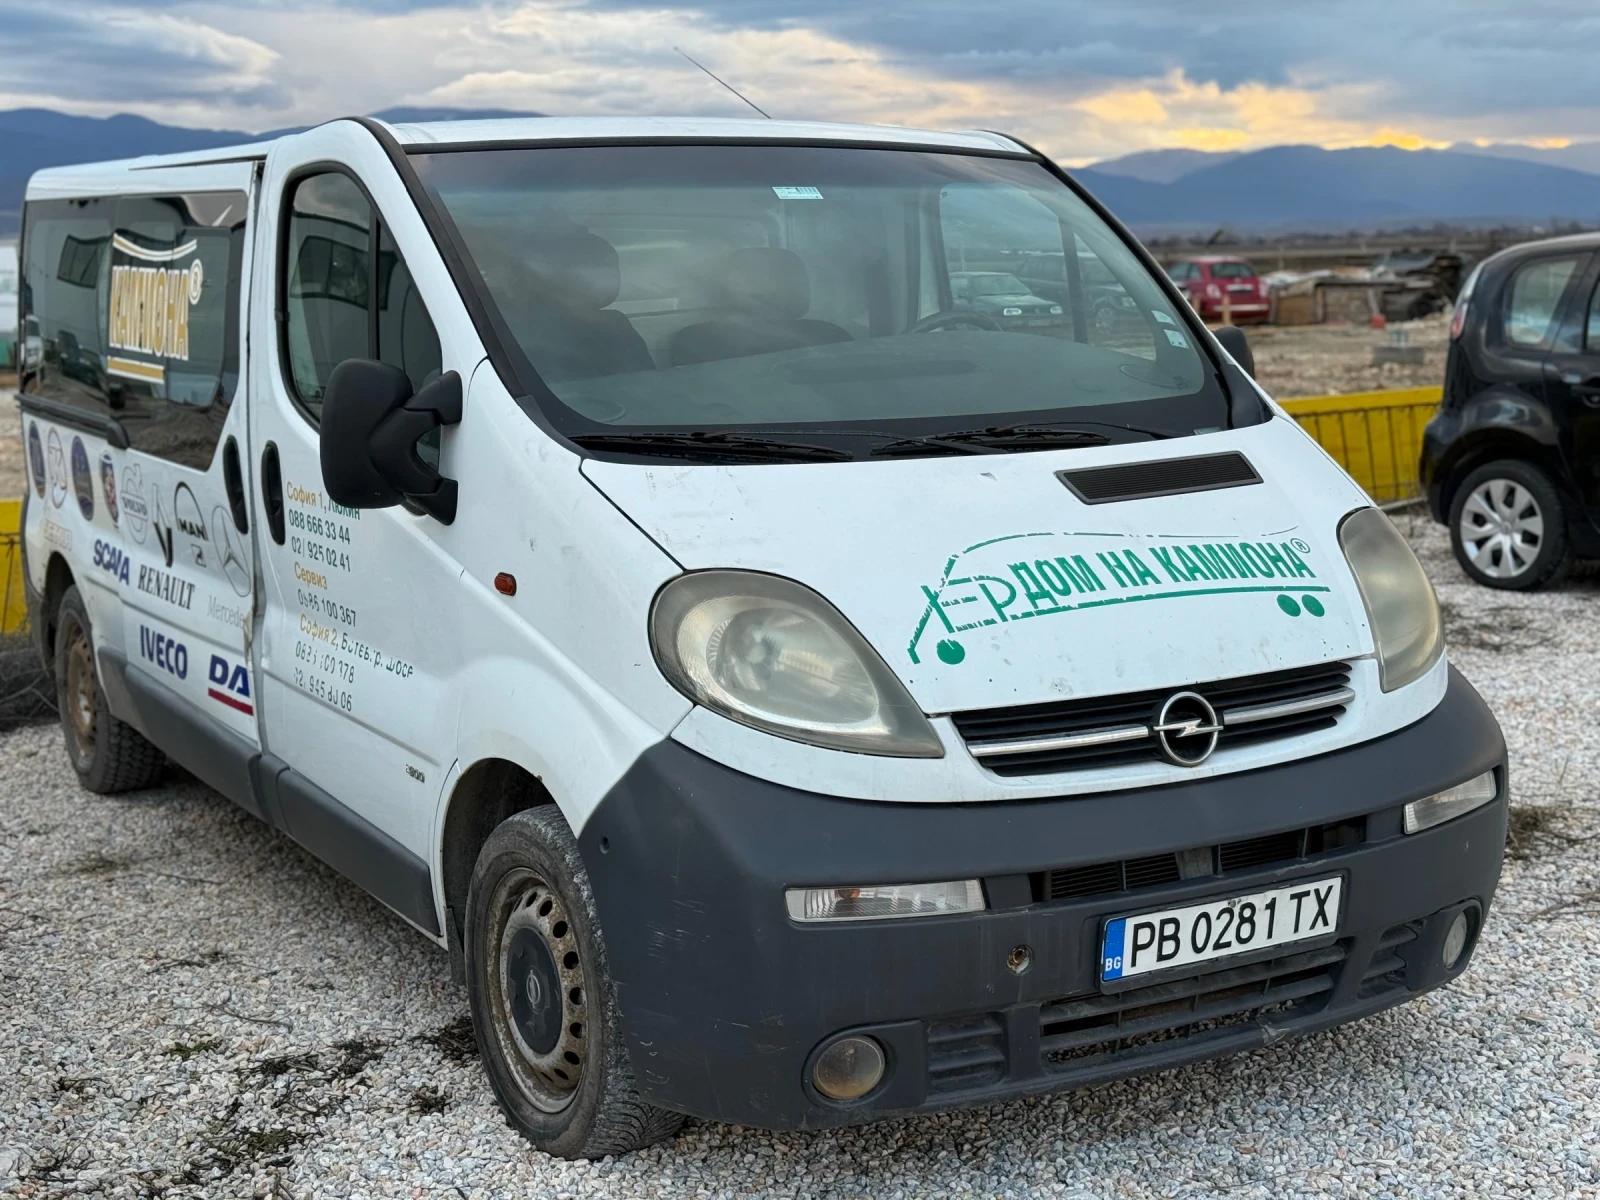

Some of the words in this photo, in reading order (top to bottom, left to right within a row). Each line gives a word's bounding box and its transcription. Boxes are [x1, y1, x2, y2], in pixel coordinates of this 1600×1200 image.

[286, 481, 317, 508] София
[178, 517, 209, 541] MAN
[288, 508, 305, 530] 088
[306, 514, 323, 536] 666
[324, 520, 337, 541] 33
[338, 525, 351, 546] 44
[307, 541, 325, 563] 925
[325, 547, 338, 569] 02
[339, 552, 351, 573] 41
[137, 564, 195, 610] RENAULT
[294, 561, 328, 590] Сервиз
[1007, 555, 1107, 609] ДОМ
[1095, 549, 1162, 588] НА
[300, 613, 330, 643] София
[321, 598, 338, 620] 100
[339, 605, 356, 628] 367
[140, 624, 188, 680] IVECO
[340, 691, 352, 713] 06
[1130, 917, 1181, 968] PB
[1191, 897, 1277, 954] 0281
[1289, 885, 1334, 934] TX
[1105, 956, 1122, 972] BG
